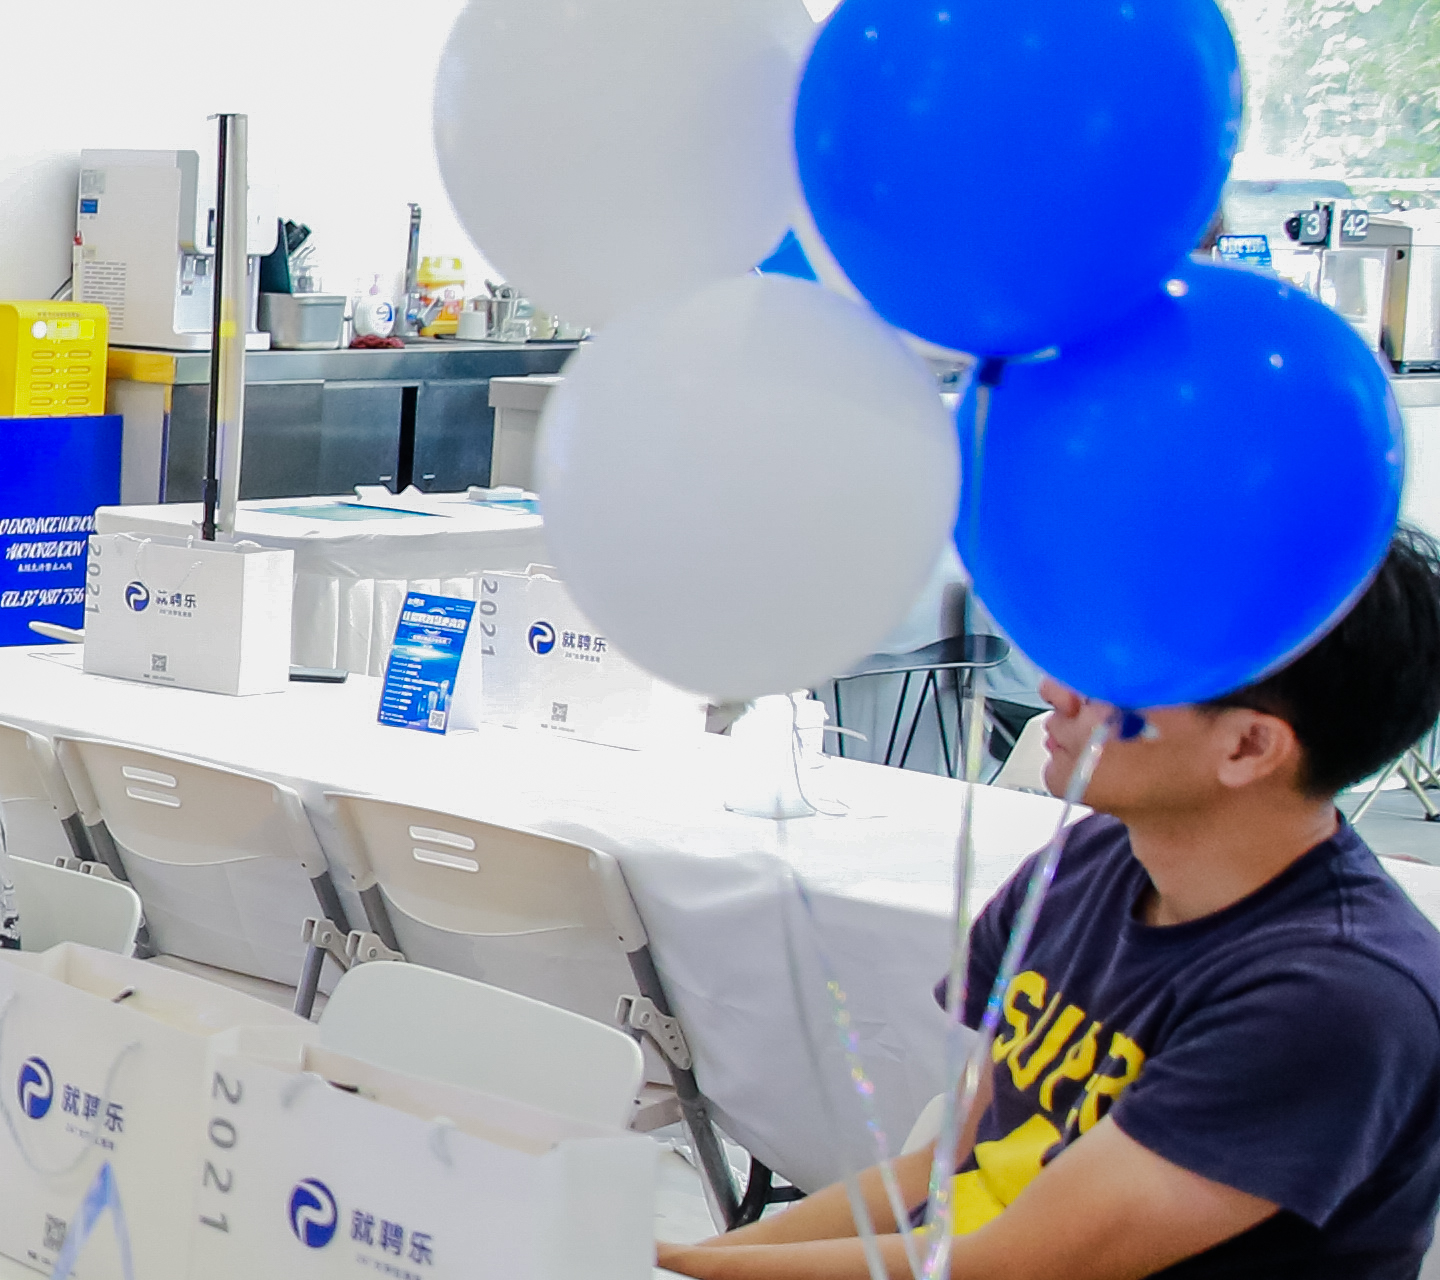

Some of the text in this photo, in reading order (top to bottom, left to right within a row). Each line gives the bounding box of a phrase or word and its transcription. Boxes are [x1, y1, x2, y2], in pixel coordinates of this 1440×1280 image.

[1343, 213, 1369, 237] 42
[86, 544, 102, 614] 2021
[480, 579, 499, 657] 2021
[562, 631, 607, 652] 就聘乐
[199, 1071, 243, 1234] 2021
[351, 1209, 433, 1266] 就聘乐
